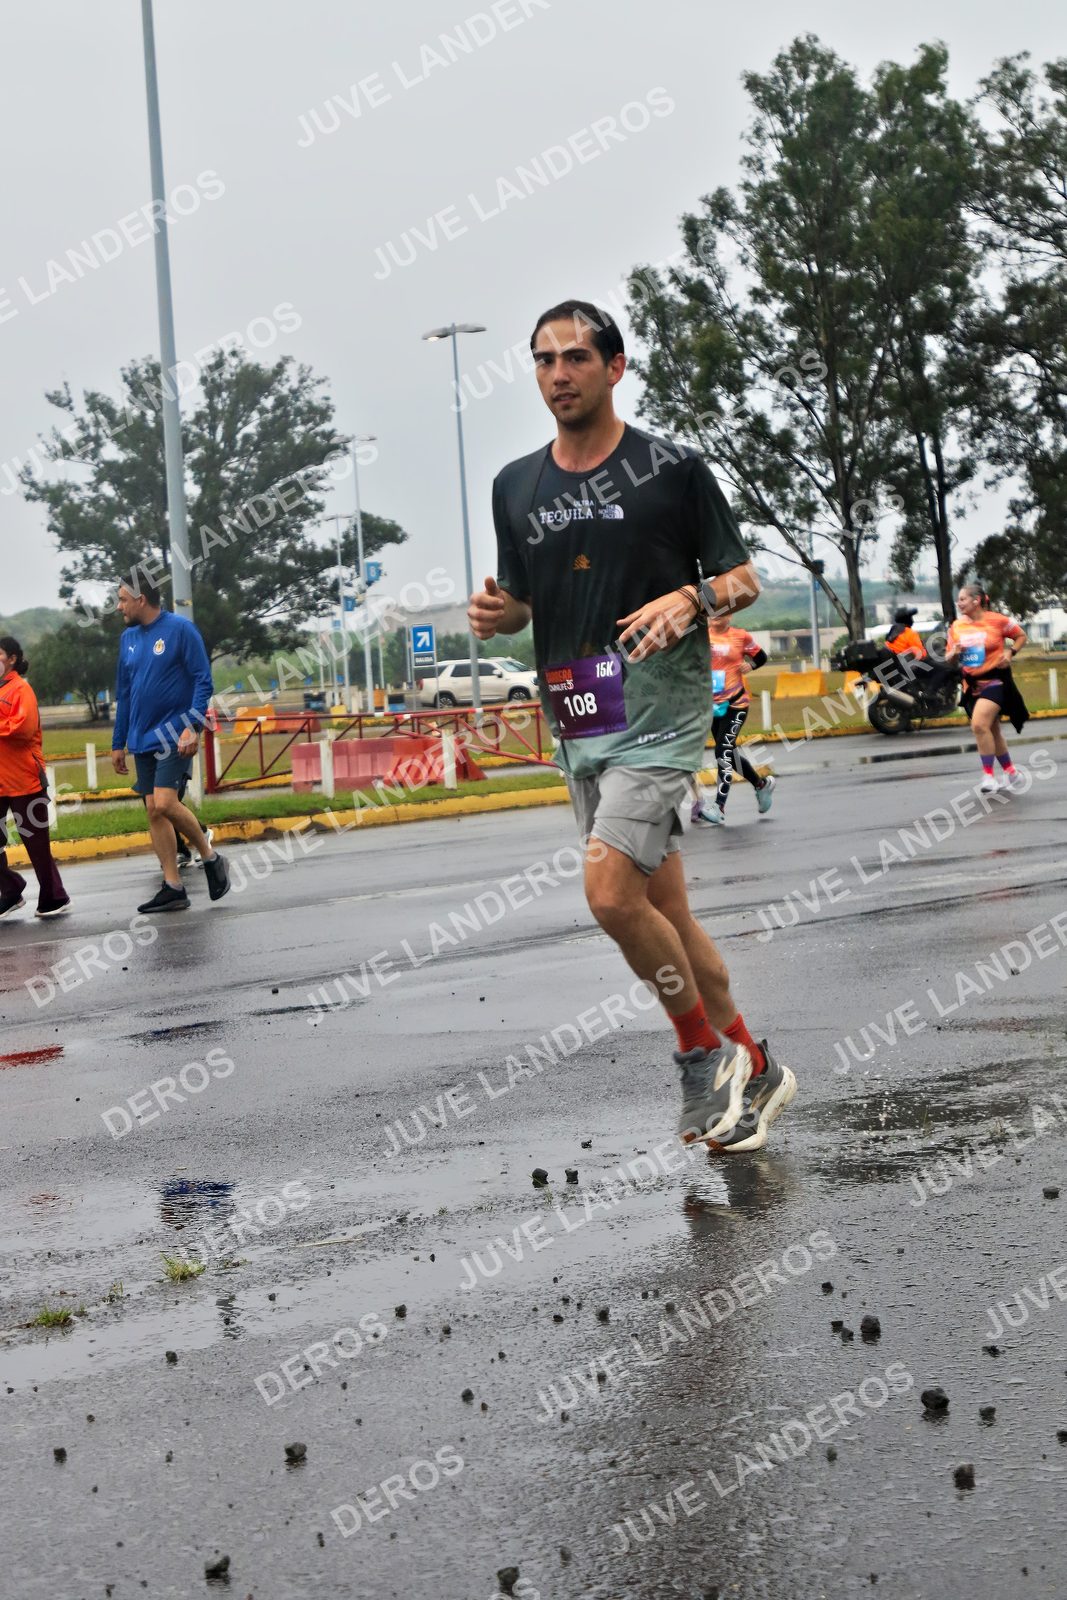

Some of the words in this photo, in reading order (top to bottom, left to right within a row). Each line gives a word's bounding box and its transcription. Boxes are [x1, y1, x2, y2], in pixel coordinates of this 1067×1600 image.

[539, 506, 594, 524] TEQUILA
[595, 661, 614, 678] 15K
[563, 692, 598, 717] 108
[721, 710, 747, 749] Klein
[717, 749, 733, 797] Calvin
